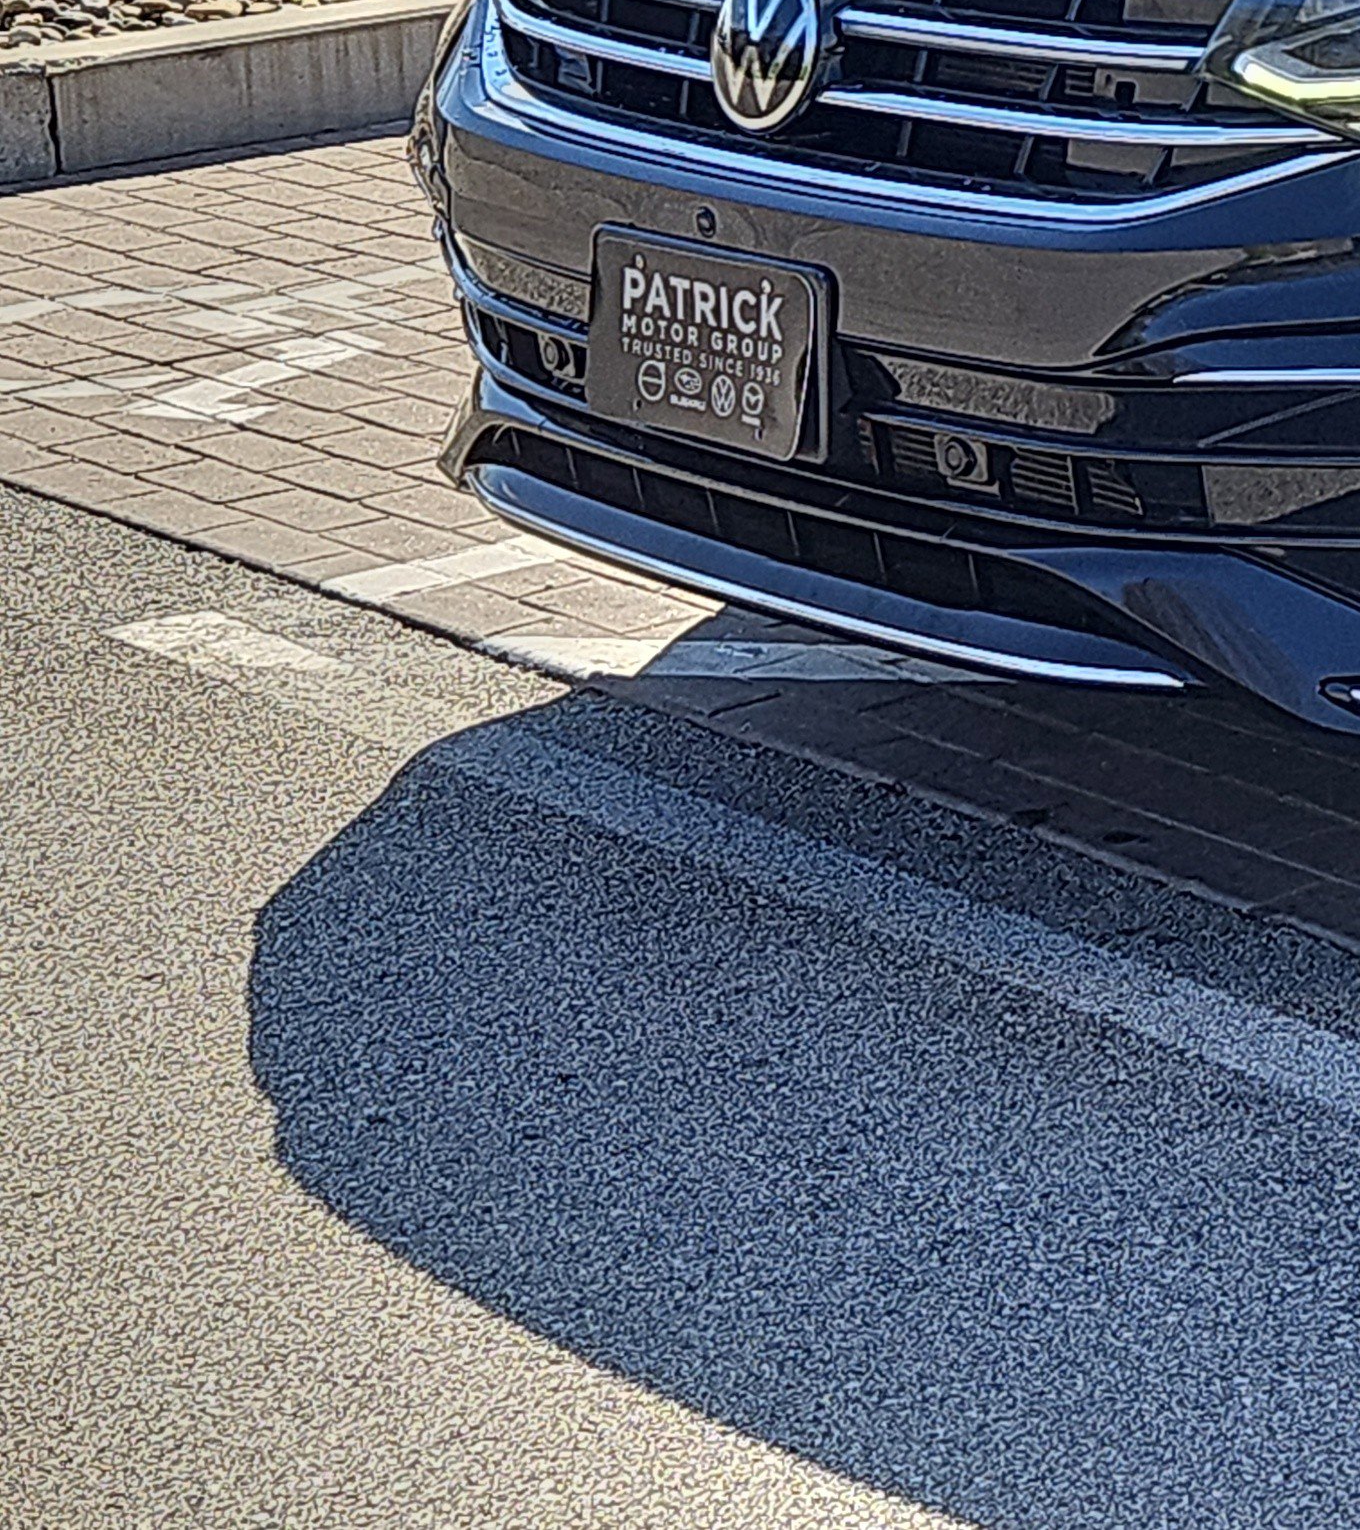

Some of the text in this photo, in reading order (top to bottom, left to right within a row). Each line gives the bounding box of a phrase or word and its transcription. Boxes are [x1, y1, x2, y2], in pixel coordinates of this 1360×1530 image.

[622, 267, 784, 341] PATRICK
[621, 314, 783, 364] MOTOR GROUP
[621, 337, 692, 365] TRUSTED
[699, 352, 744, 377] SINCE
